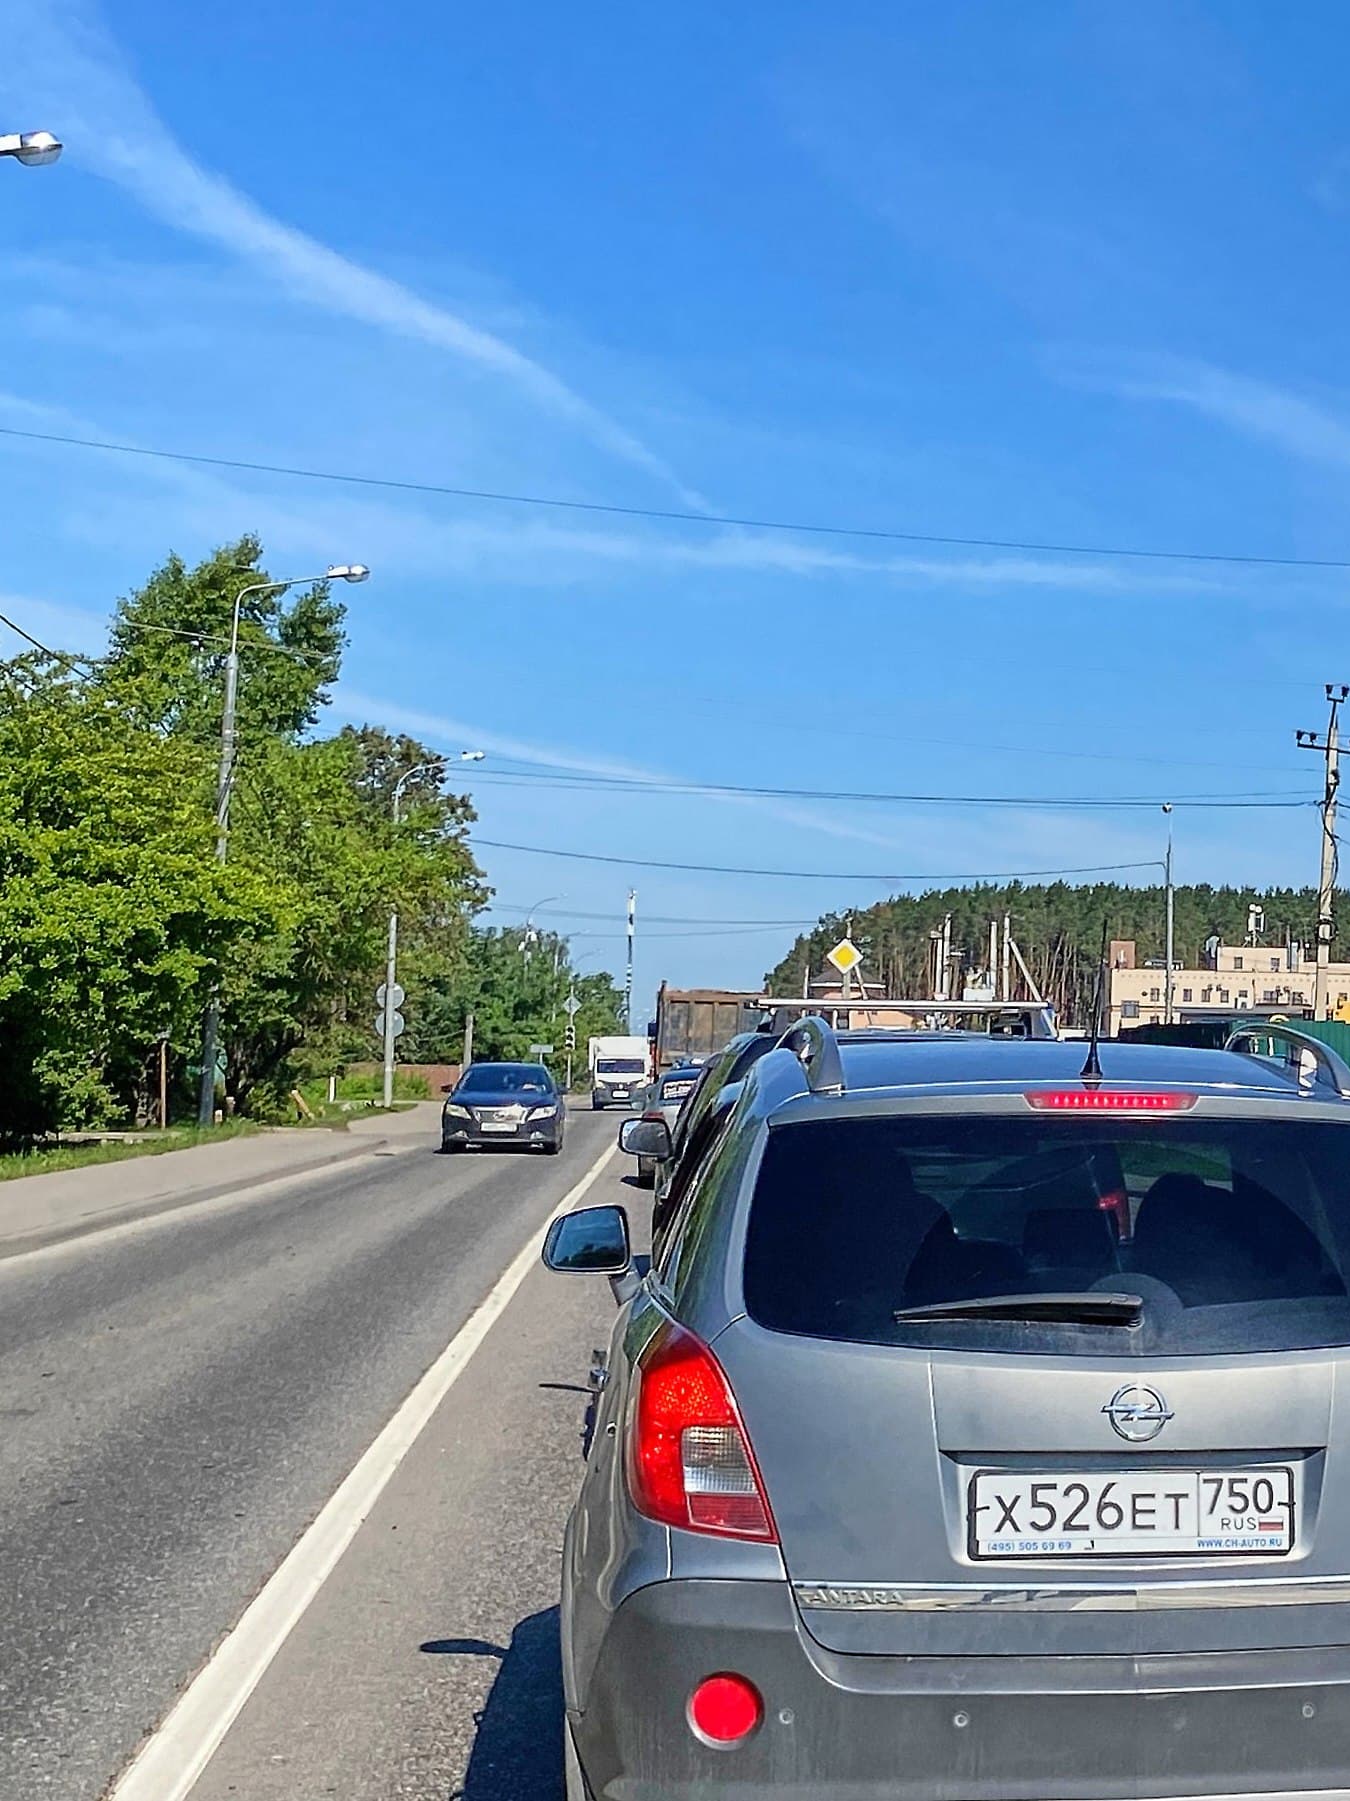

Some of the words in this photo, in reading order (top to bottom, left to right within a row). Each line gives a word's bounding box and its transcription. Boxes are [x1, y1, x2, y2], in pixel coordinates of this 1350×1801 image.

[1202, 1478, 1274, 1515] 750
[1220, 1516, 1257, 1530] RUS
[987, 1542, 1015, 1552] (495)
[1018, 1542, 1039, 1552] 505
[805, 1588, 904, 1606] ANTARA
